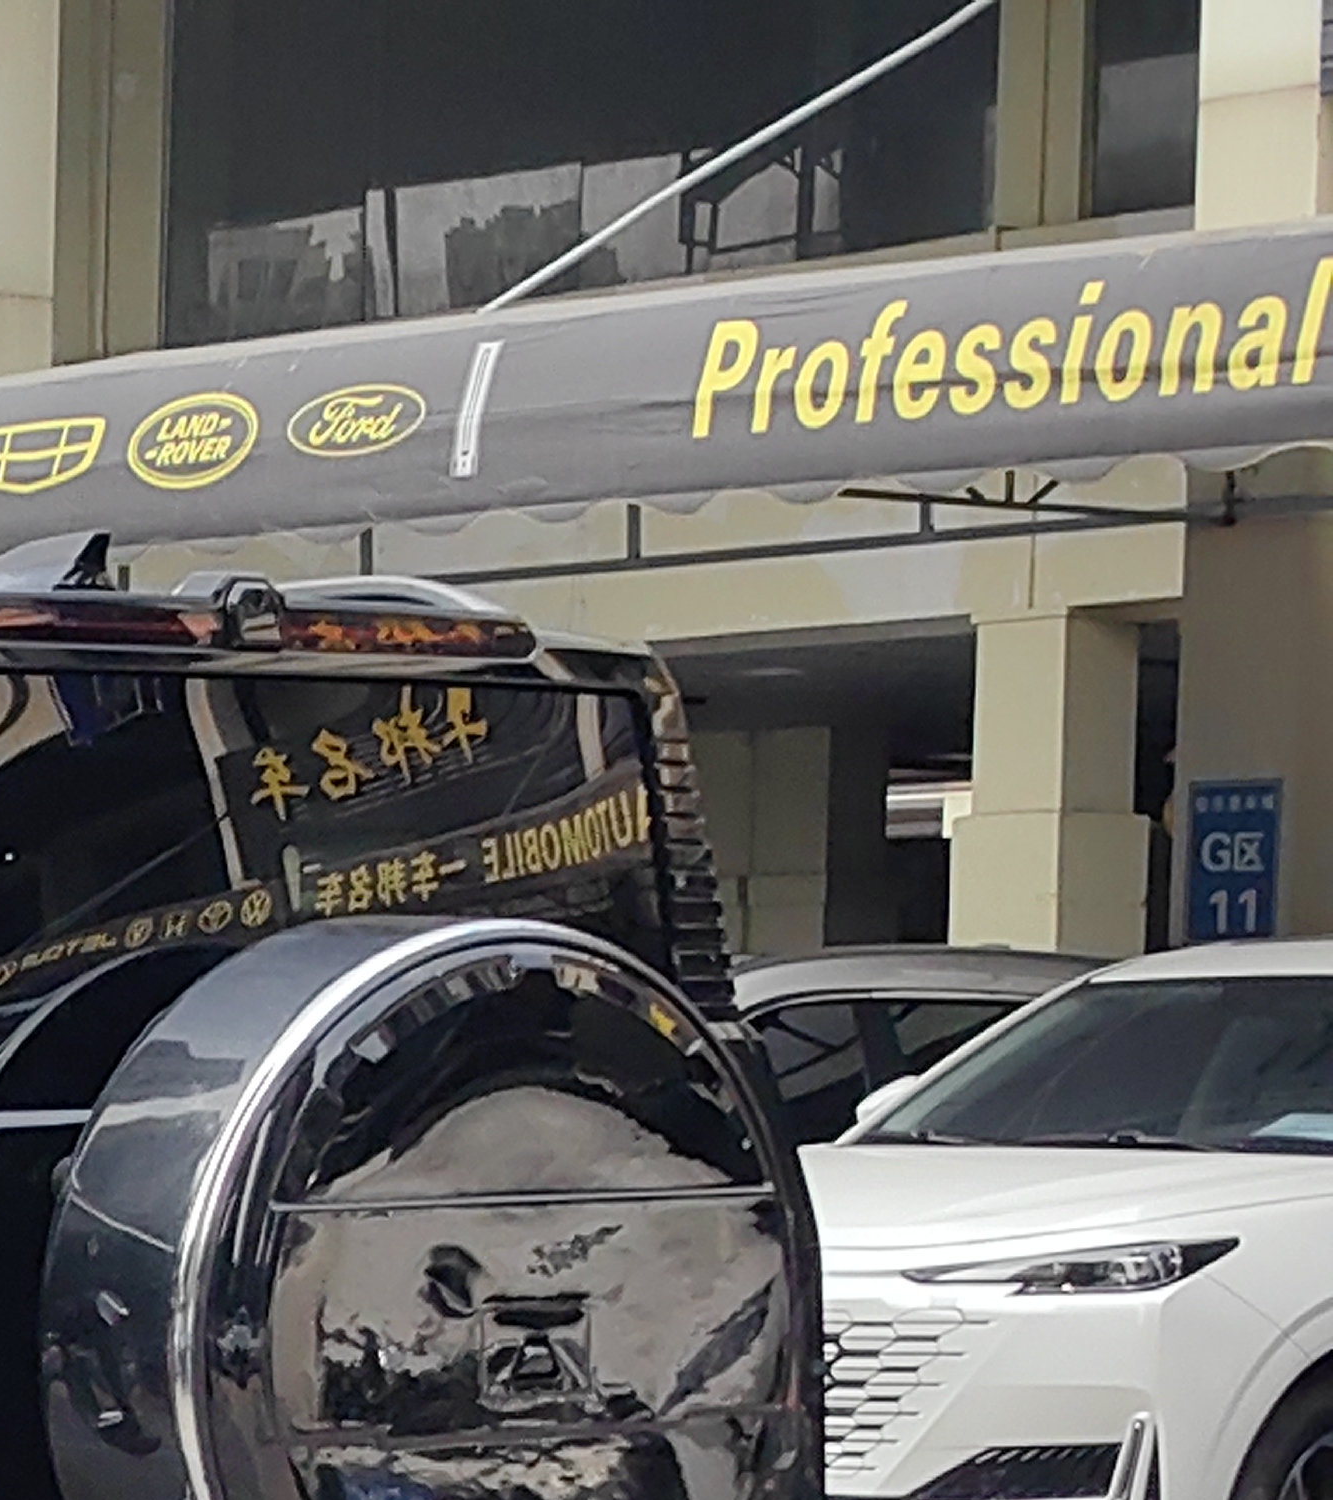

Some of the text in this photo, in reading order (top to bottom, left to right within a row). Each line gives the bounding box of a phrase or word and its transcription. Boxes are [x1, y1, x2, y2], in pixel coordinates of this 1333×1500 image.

[691, 256, 1333, 440] Professional
[156, 411, 220, 443] LAND
[309, 394, 404, 446] Ford
[154, 434, 233, 467] ROVER
[1201, 831, 1265, 872] G区
[1209, 889, 1257, 934] 11
